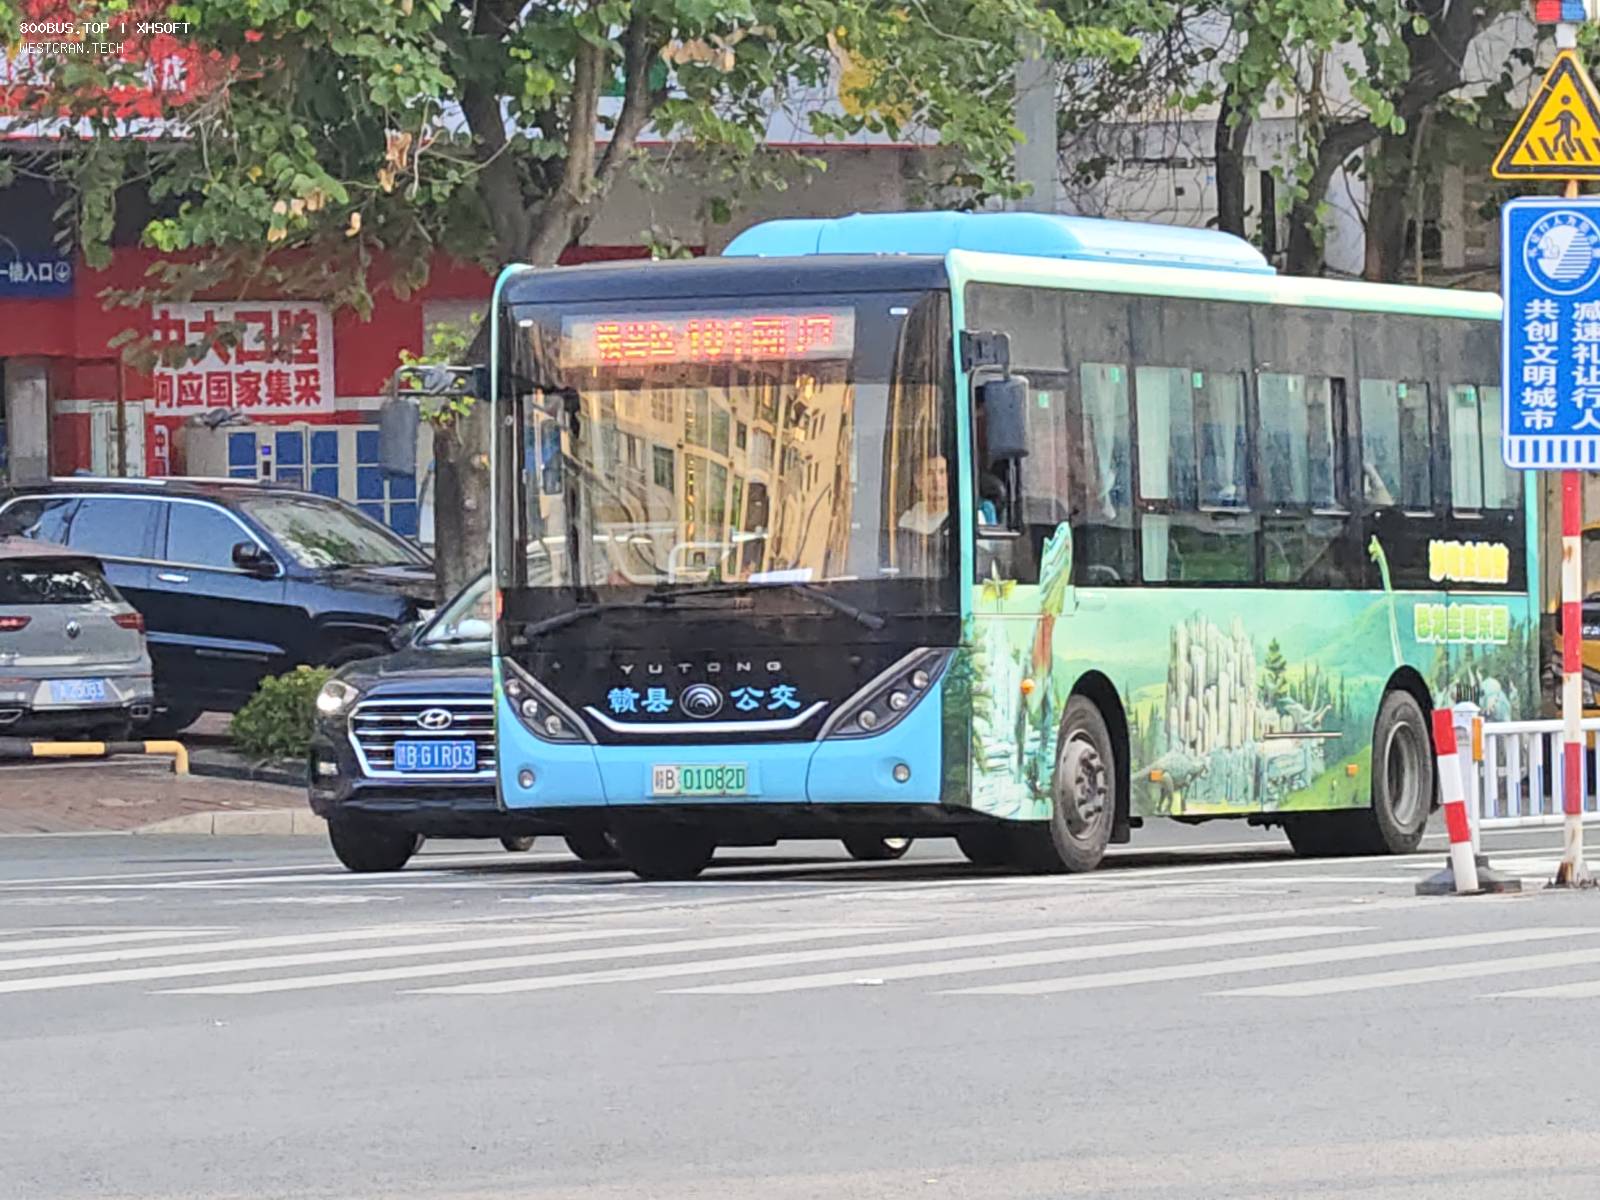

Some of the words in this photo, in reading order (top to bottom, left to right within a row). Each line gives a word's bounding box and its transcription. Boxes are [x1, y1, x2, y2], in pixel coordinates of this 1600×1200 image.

[1520, 298, 1560, 431] 共创文明城市
[1570, 302, 1600, 430] 减速礼让行人
[607, 686, 674, 714] 赣县
[730, 684, 801, 711] 公交
[620, 661, 782, 675] YUTONG
